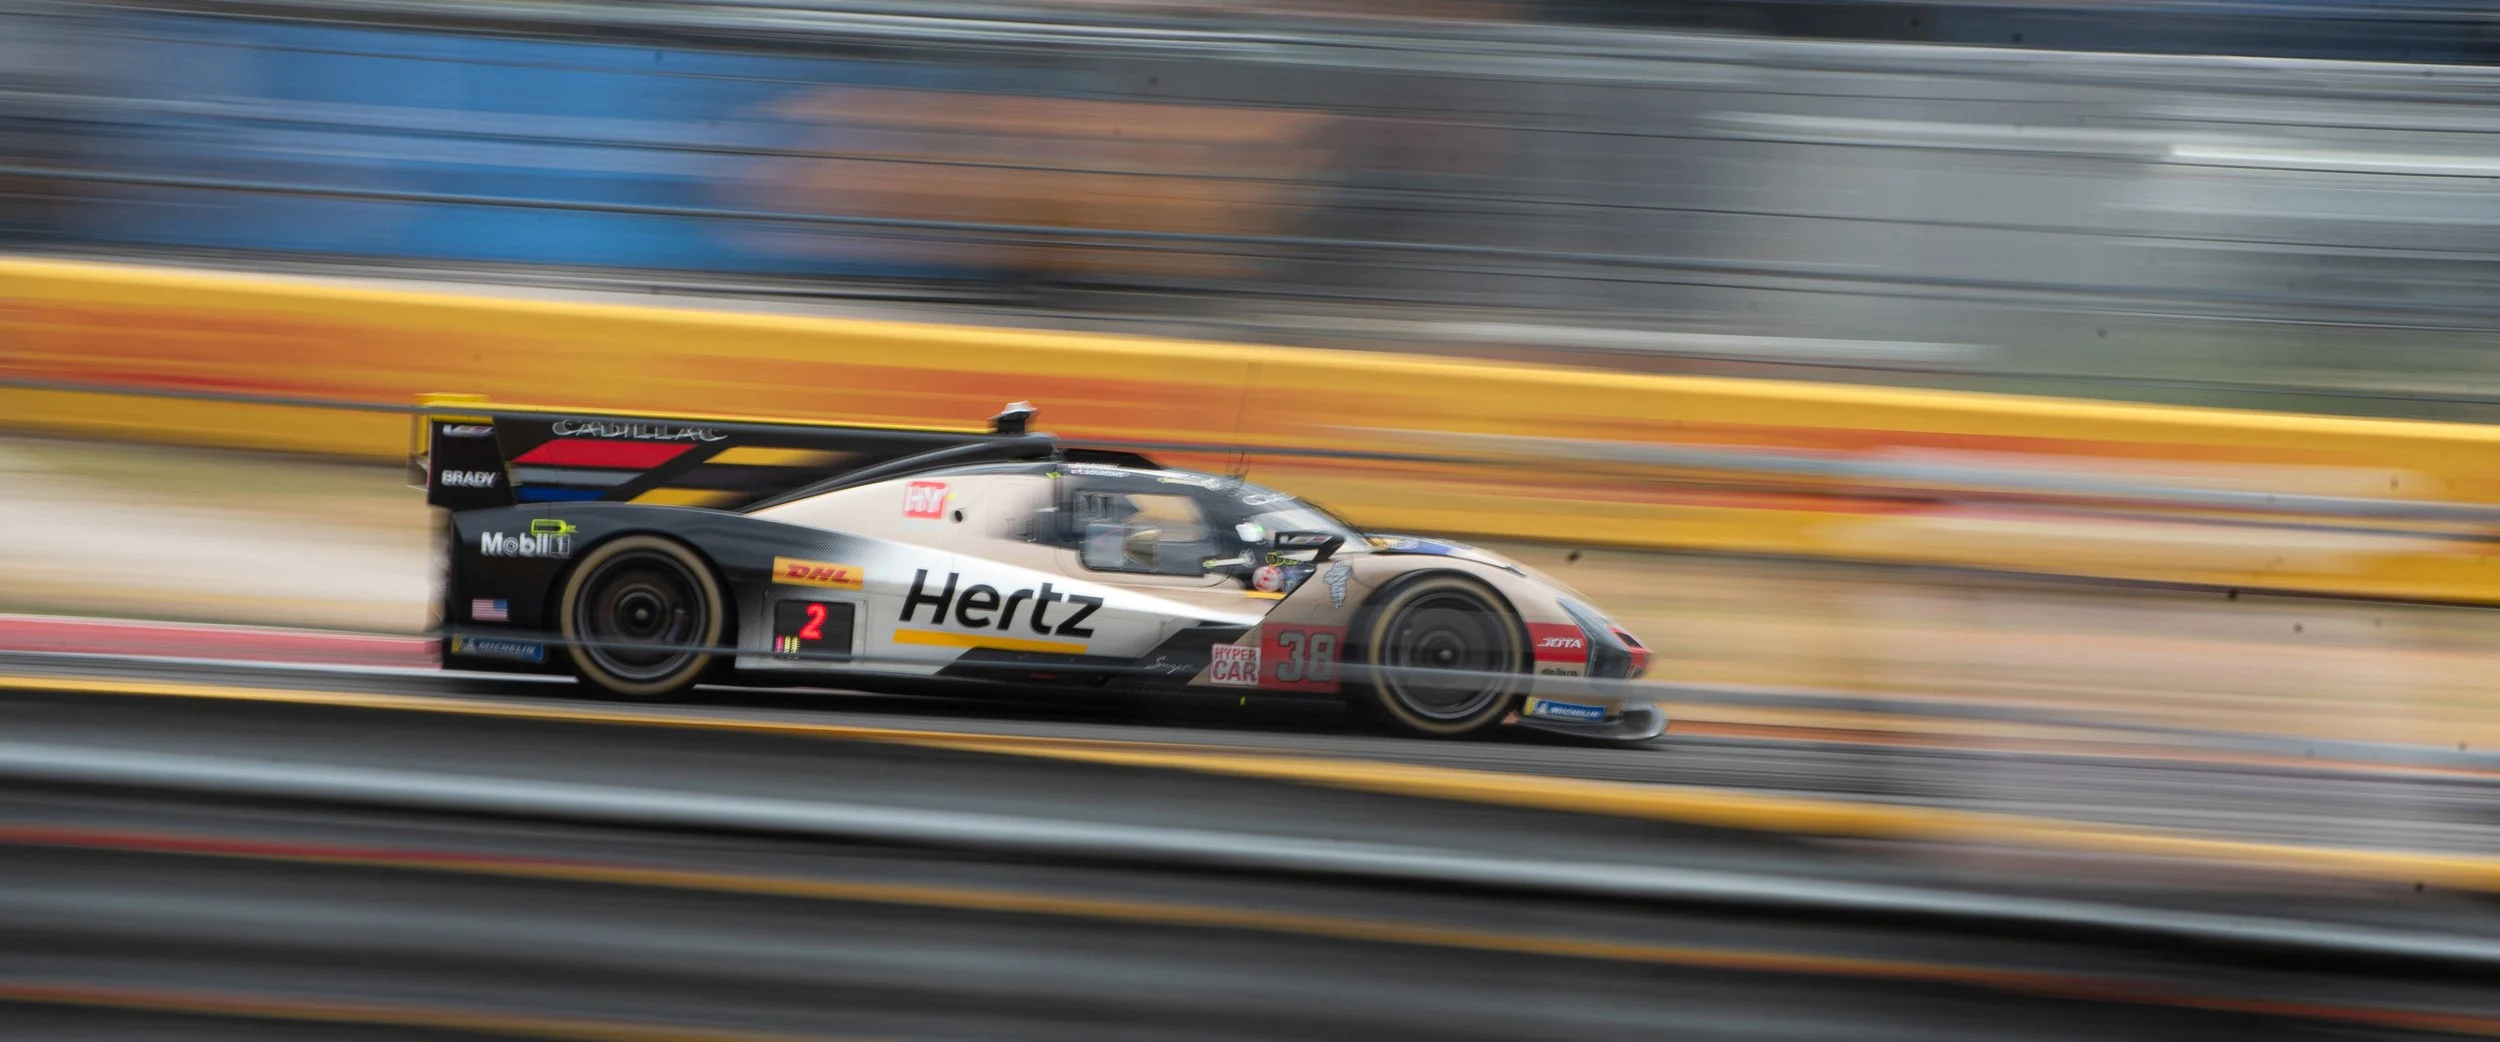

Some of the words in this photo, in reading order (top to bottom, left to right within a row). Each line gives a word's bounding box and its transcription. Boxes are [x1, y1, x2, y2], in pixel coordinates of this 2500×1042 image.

[552, 418, 727, 442] CADILLAC
[441, 470, 496, 487] BRADY
[481, 532, 548, 557] Mobil
[785, 566, 850, 584] DHL
[899, 568, 1104, 638] Hertz
[800, 603, 827, 640] 2
[479, 641, 536, 656] MICHELIN
[1537, 637, 1584, 648] JOTA
[1215, 648, 1256, 661] HYPER
[1276, 632, 1336, 682] 38
[1213, 661, 1257, 681] CAR
